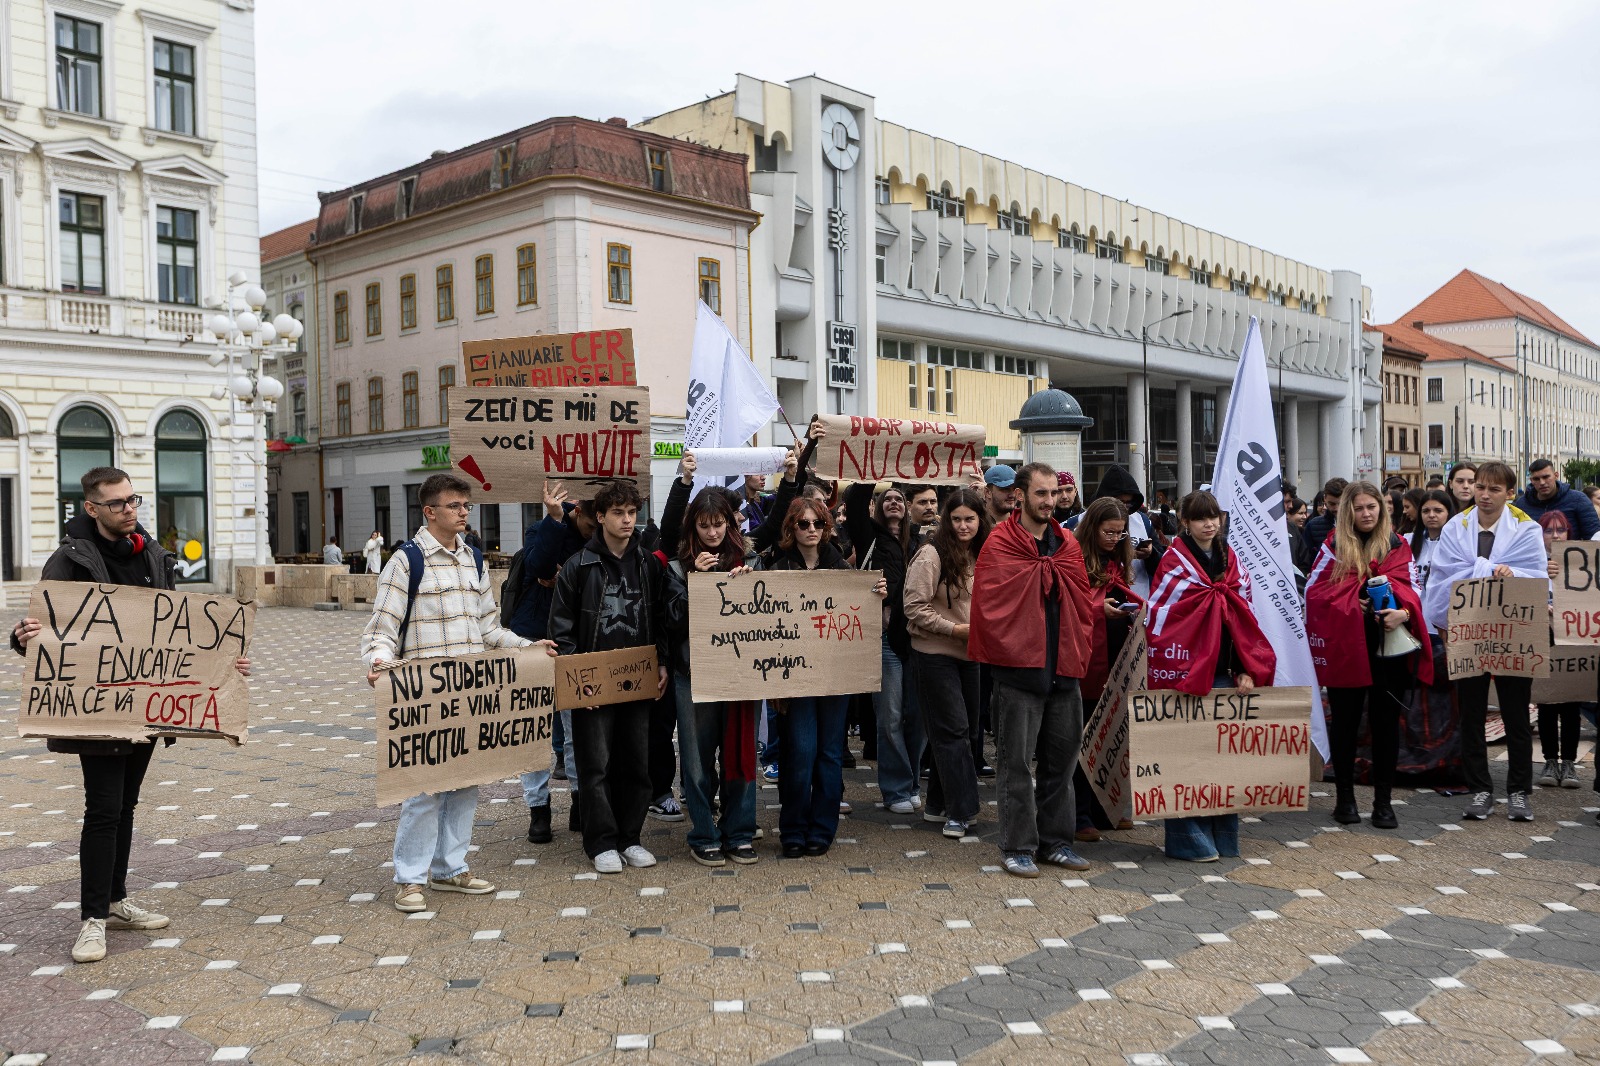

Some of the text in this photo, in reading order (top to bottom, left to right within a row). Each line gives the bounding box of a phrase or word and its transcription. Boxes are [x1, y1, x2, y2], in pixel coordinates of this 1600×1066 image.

[491, 330, 626, 370] IANUARIE CFR
[833, 327, 854, 347] CASA
[839, 347, 850, 364] DE
[531, 362, 638, 387] BURSELE
[464, 396, 518, 422] ZECI
[523, 398, 554, 422] DE
[609, 400, 640, 424] DE
[850, 415, 903, 437] DOAR
[838, 439, 978, 480] NU COSTĂ
[824, 596, 838, 610] a
[1254, 573, 1270, 590] din
[1268, 593, 1304, 640] România
[1452, 577, 1504, 615] ȘTIȚI
[43, 584, 253, 655] VĂ PASĂ
[811, 605, 863, 642] FĂRĂ
[1164, 642, 1189, 660] din
[1310, 632, 1325, 648] din
[1519, 643, 1535, 656] LA
[34, 642, 196, 685] DE EDUCAȚIE
[1312, 656, 1327, 666] ara
[388, 657, 517, 704] NU STUDENȚII
[565, 666, 598, 687] NET
[27, 681, 220, 731] PÂNĂ CE VĂ COSTĂ
[388, 686, 554, 730] SUNT DE VINĂ PENTRU
[1133, 693, 1261, 723] EDUCAȚIA ESTE
[388, 713, 552, 768] DEFICITUL BUGETAR!
[1216, 722, 1309, 756] PRIORITARĂ
[1136, 763, 1161, 777] DAR
[1108, 778, 1121, 806] NU
[1134, 782, 1306, 816] DUPĂ PENSIILE SPECIALE
